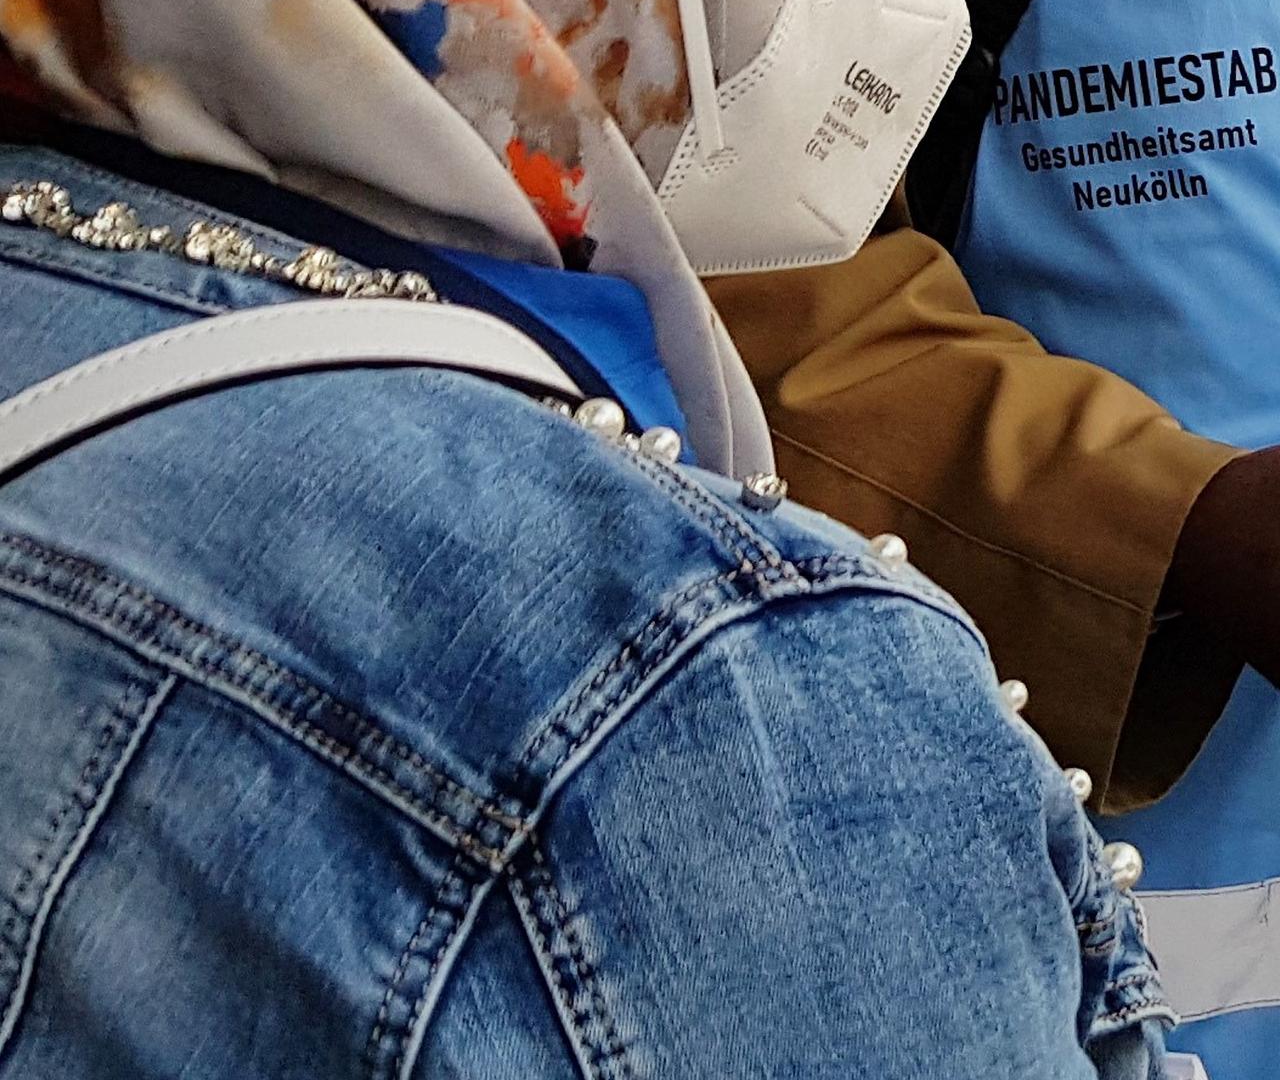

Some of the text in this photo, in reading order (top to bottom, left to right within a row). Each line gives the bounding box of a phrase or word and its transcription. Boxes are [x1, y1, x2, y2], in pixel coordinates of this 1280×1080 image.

[844, 60, 902, 114] LEIKANG
[993, 46, 1278, 126] PANDEMIESTAB
[1021, 119, 1258, 172] Gesundheitsamt
[1072, 169, 1209, 211] Neukölln
